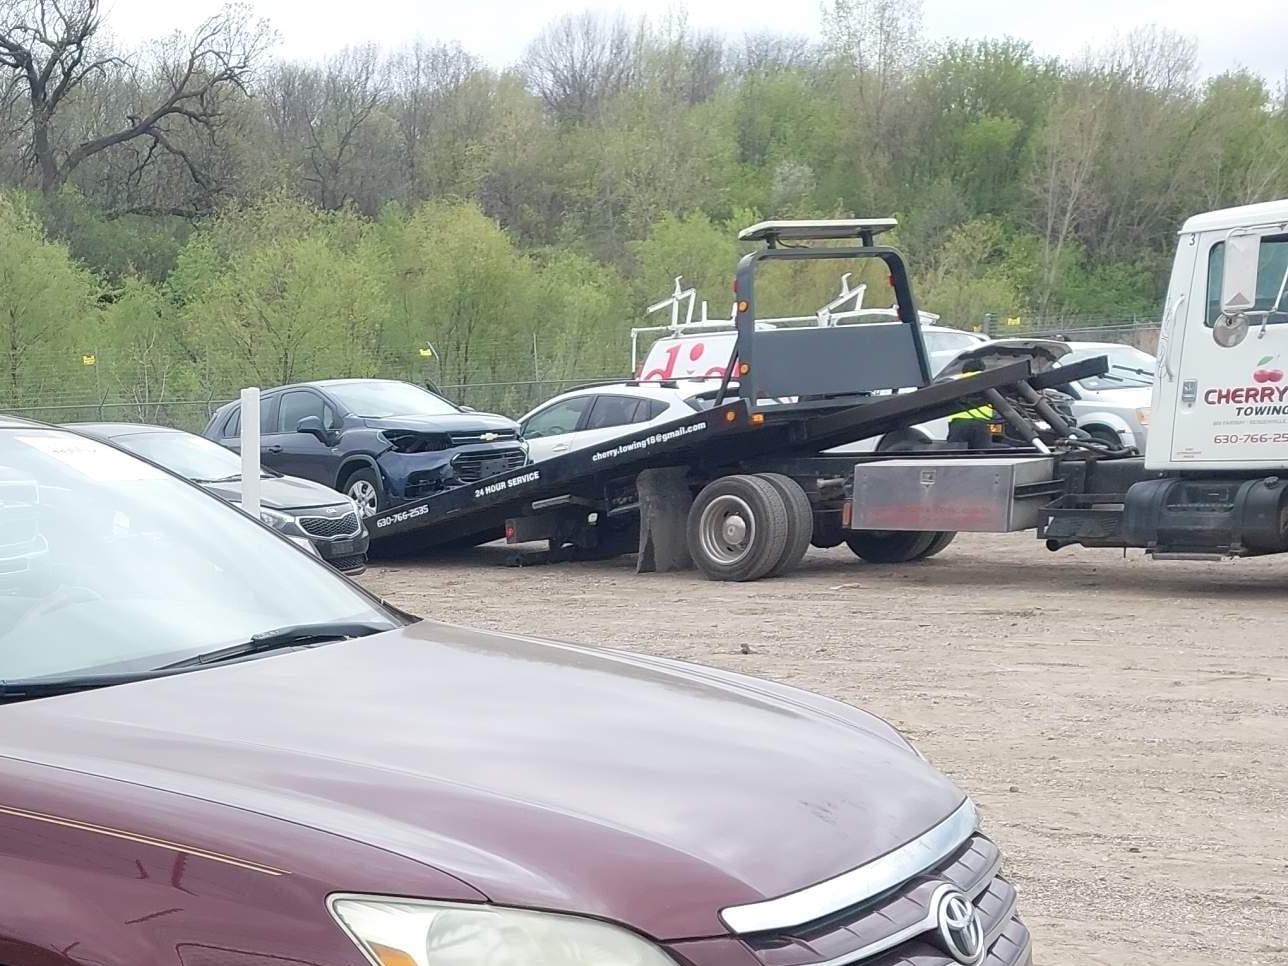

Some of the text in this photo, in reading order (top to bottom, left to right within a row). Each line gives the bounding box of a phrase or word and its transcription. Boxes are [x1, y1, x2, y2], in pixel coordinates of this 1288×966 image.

[1189, 233, 1196, 246] 3
[1204, 385, 1288, 405] CHERRY
[592, 422, 706, 462] cherry.towing18@gmail.com
[474, 470, 540, 498] 24 HOUR SERVICE
[376, 504, 429, 528] 630-766-2535
